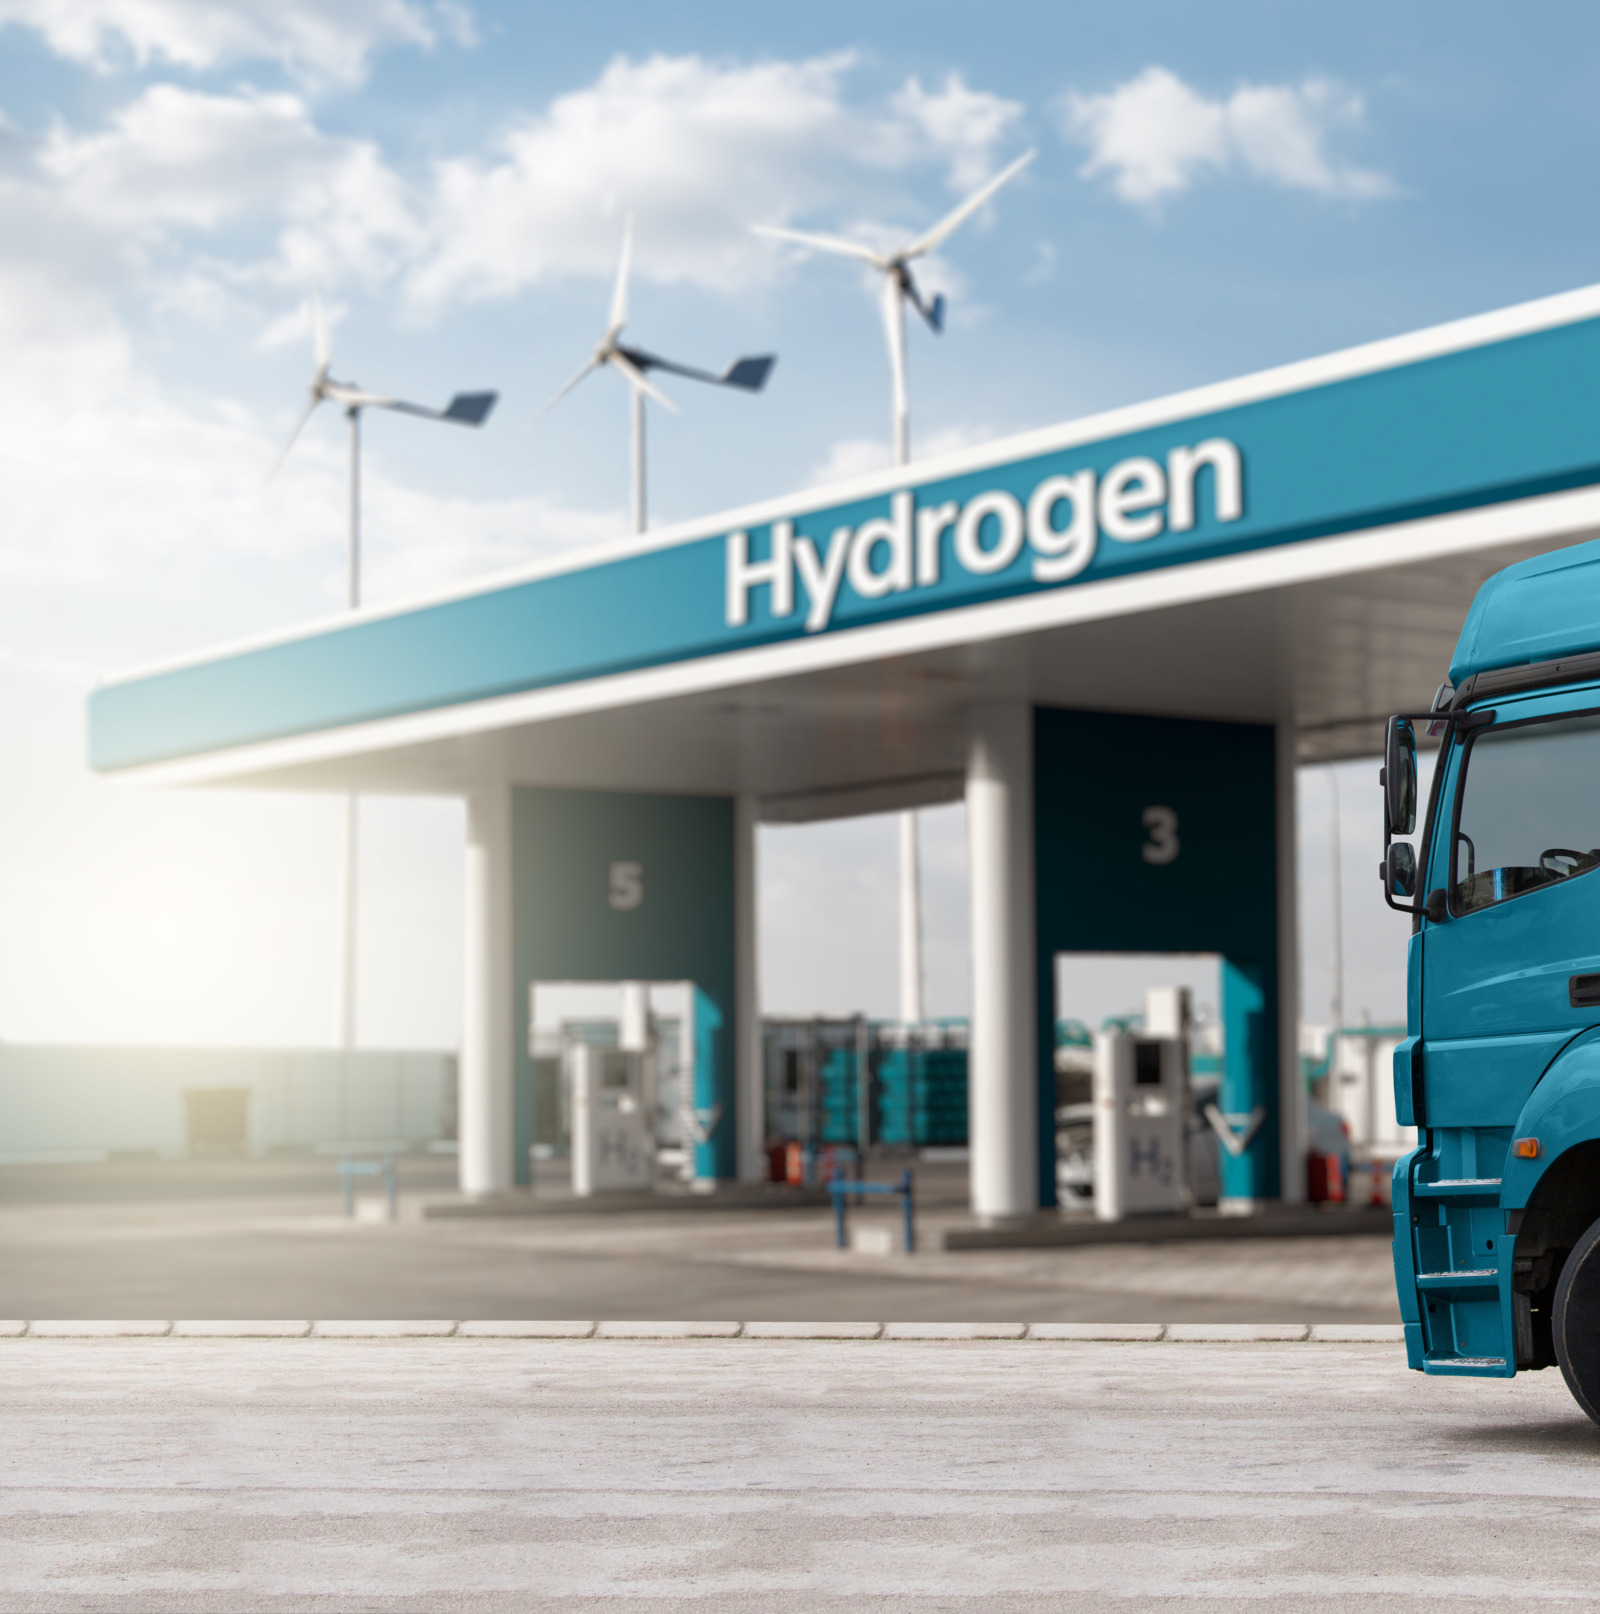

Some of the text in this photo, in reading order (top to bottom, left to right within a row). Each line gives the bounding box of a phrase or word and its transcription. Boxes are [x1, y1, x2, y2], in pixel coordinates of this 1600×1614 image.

[725, 437, 1243, 633] Hydrogen
[1142, 805, 1180, 865] 3
[608, 861, 644, 911] 5
